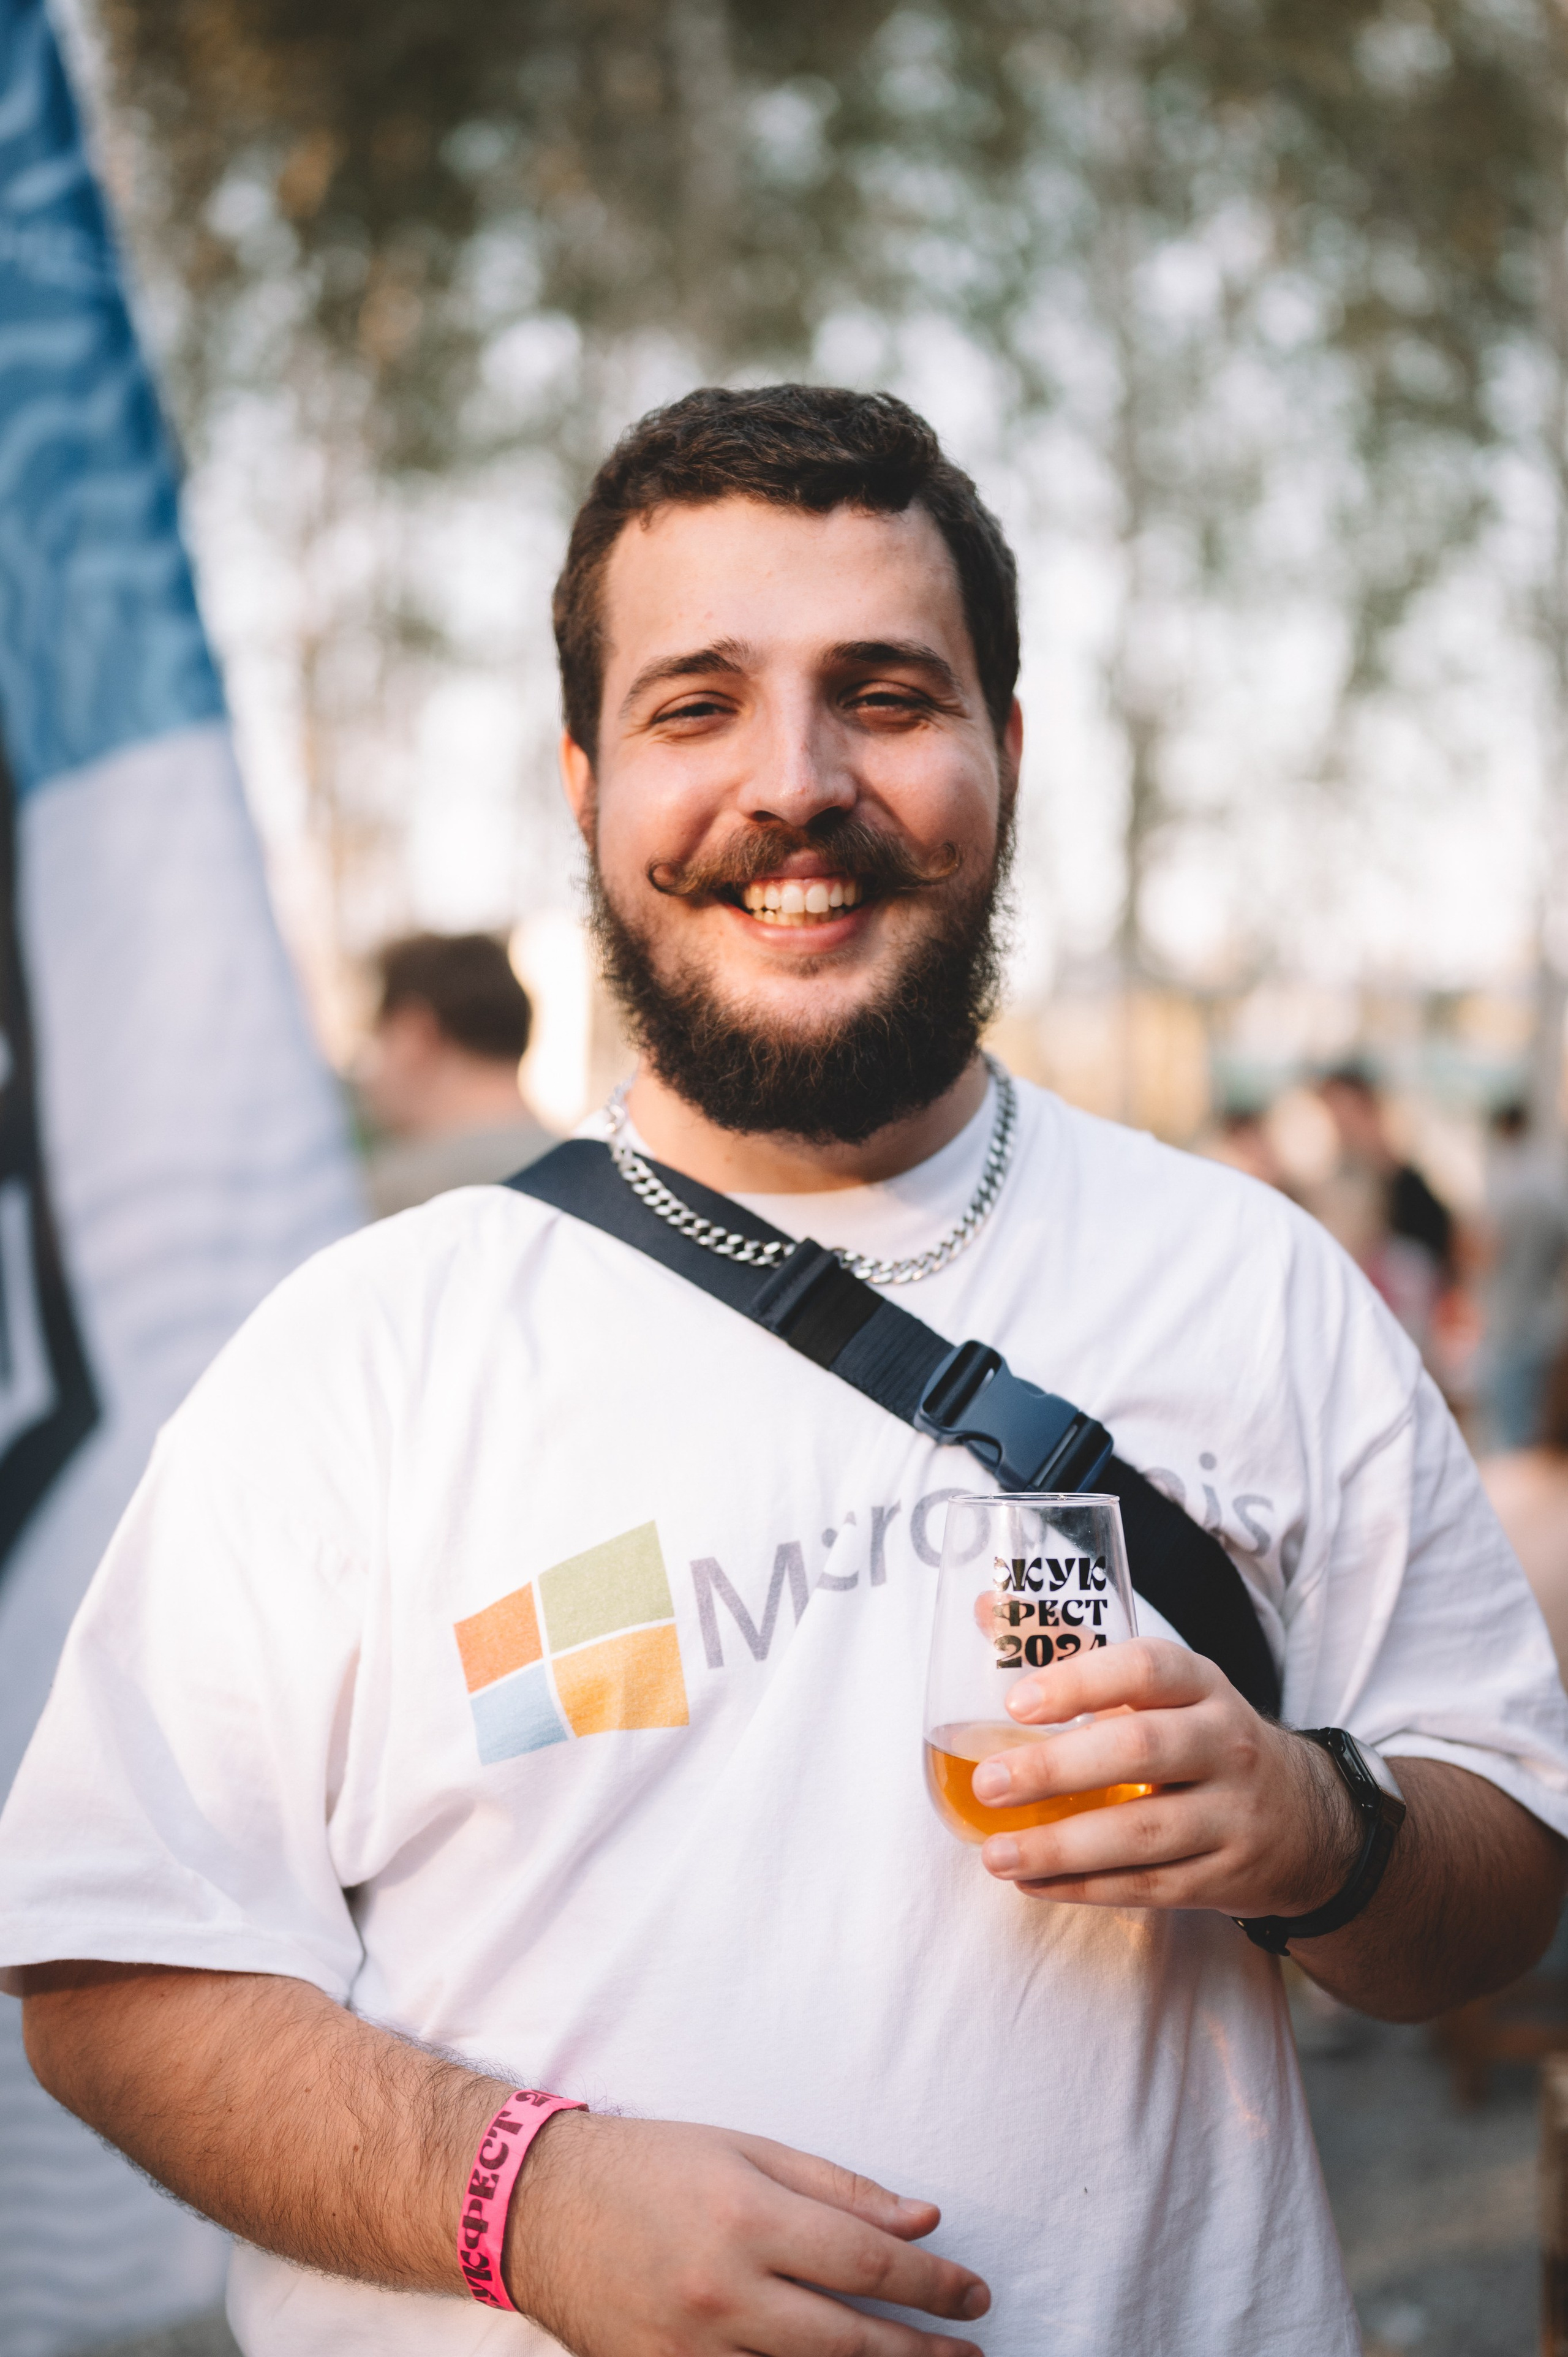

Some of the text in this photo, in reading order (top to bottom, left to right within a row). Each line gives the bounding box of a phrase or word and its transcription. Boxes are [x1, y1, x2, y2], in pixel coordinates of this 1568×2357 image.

[993, 1556, 1106, 1591] ЖУК
[993, 1599, 1107, 1626] ФЕСТ
[462, 2110, 524, 2249] ФЕСТ
[461, 2250, 508, 2309] УК
